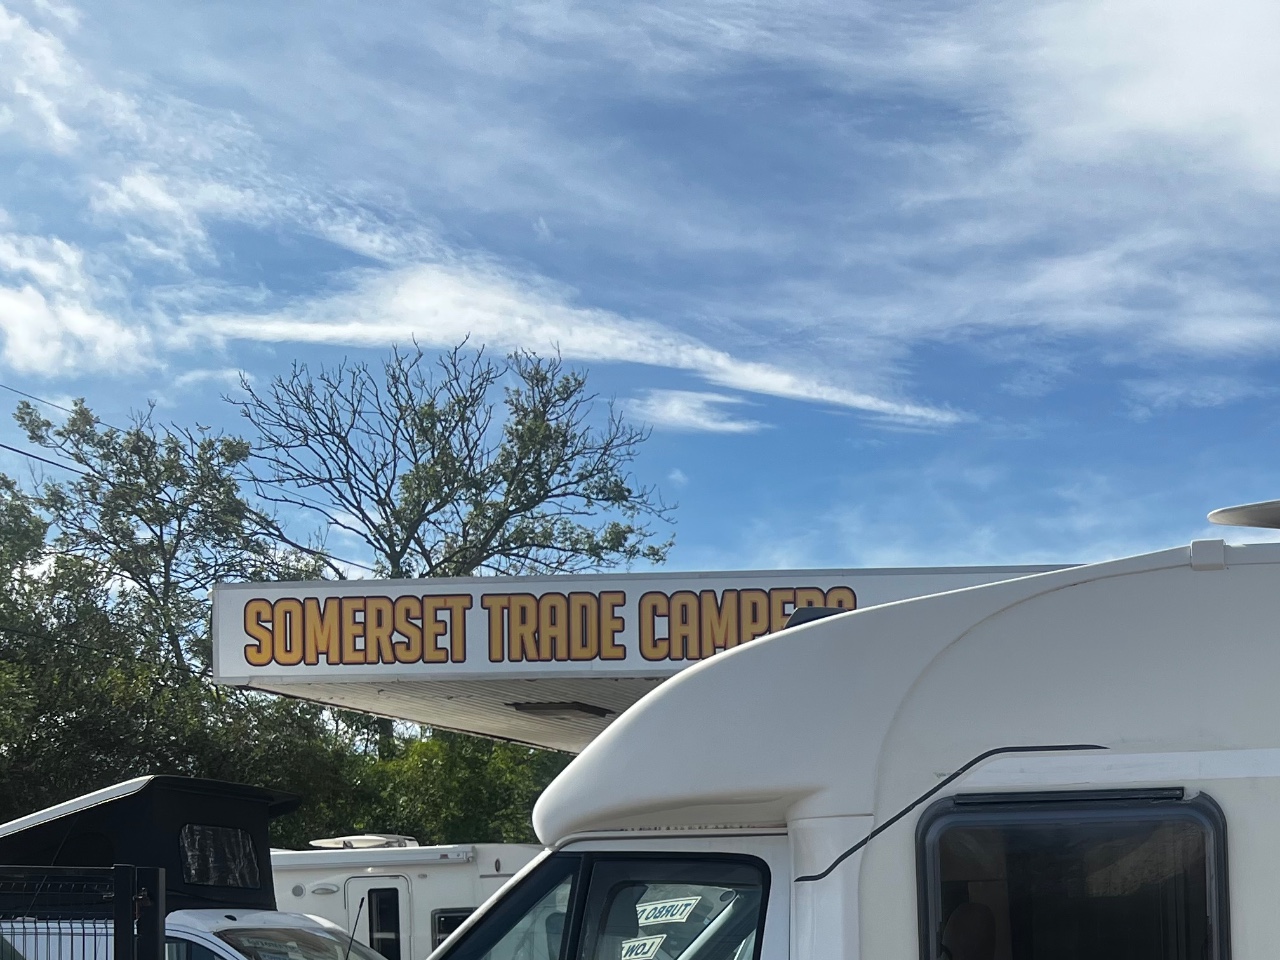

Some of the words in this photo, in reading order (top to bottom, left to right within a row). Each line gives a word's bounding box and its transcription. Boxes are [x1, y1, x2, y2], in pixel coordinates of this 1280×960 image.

[244, 595, 473, 666] SOMERSET
[481, 591, 626, 662] TRADE
[639, 586, 857, 661] CAMPE
